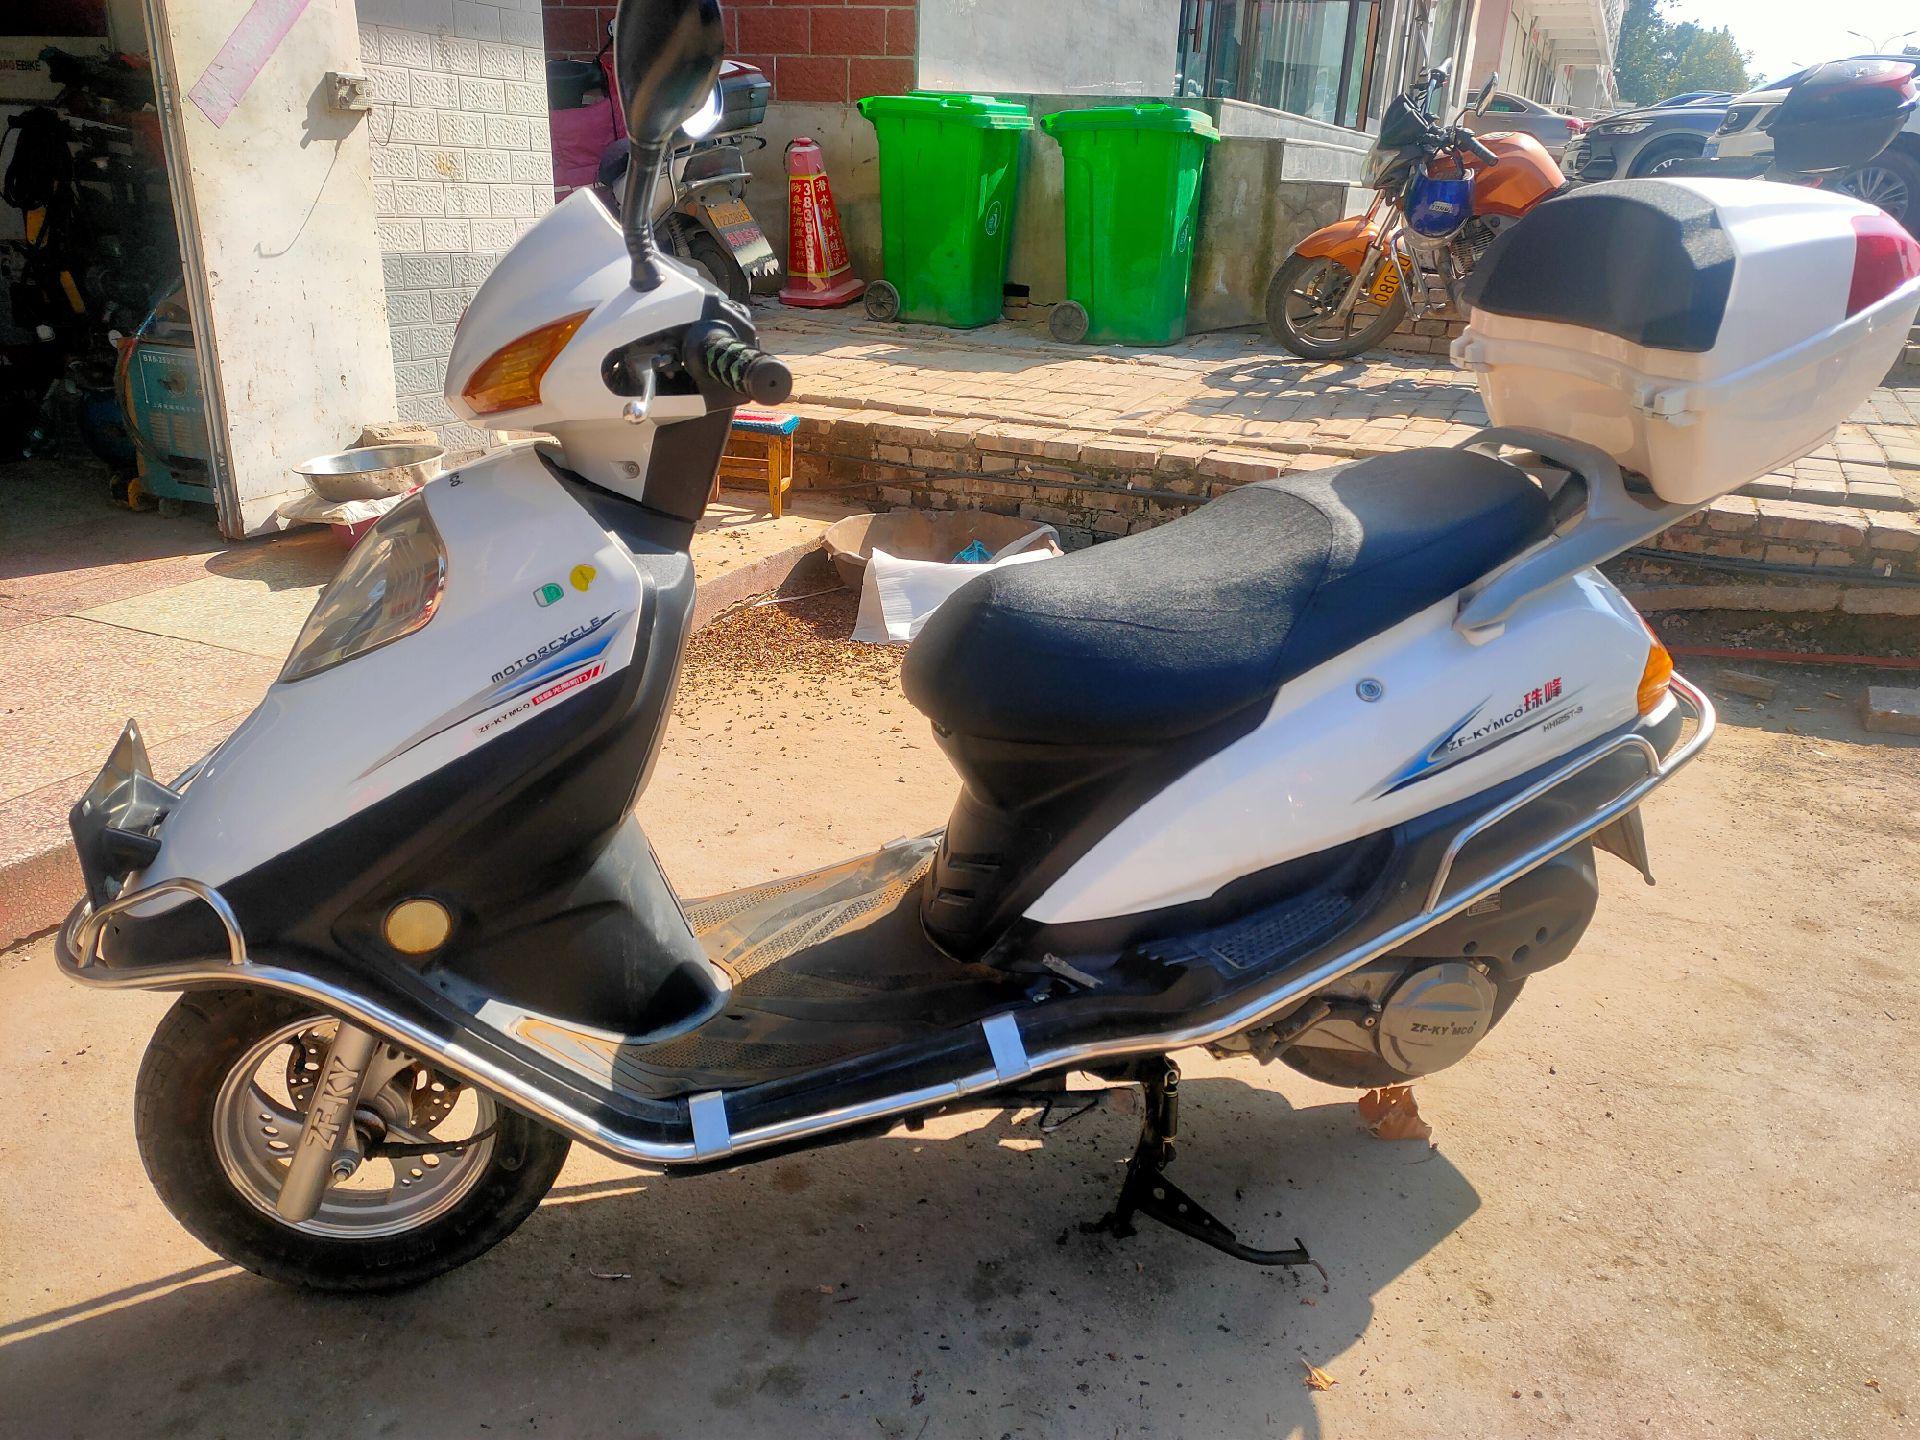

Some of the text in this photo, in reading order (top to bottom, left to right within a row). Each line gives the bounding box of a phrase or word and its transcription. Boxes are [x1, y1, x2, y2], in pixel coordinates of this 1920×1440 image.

[491, 616, 601, 684] MOTORCYCLE
[477, 703, 531, 733] ZF-KYMCO
[1447, 676, 1564, 752] ZF-KYMCO 珠峰
[305, 1056, 358, 1152] ZF-KY
